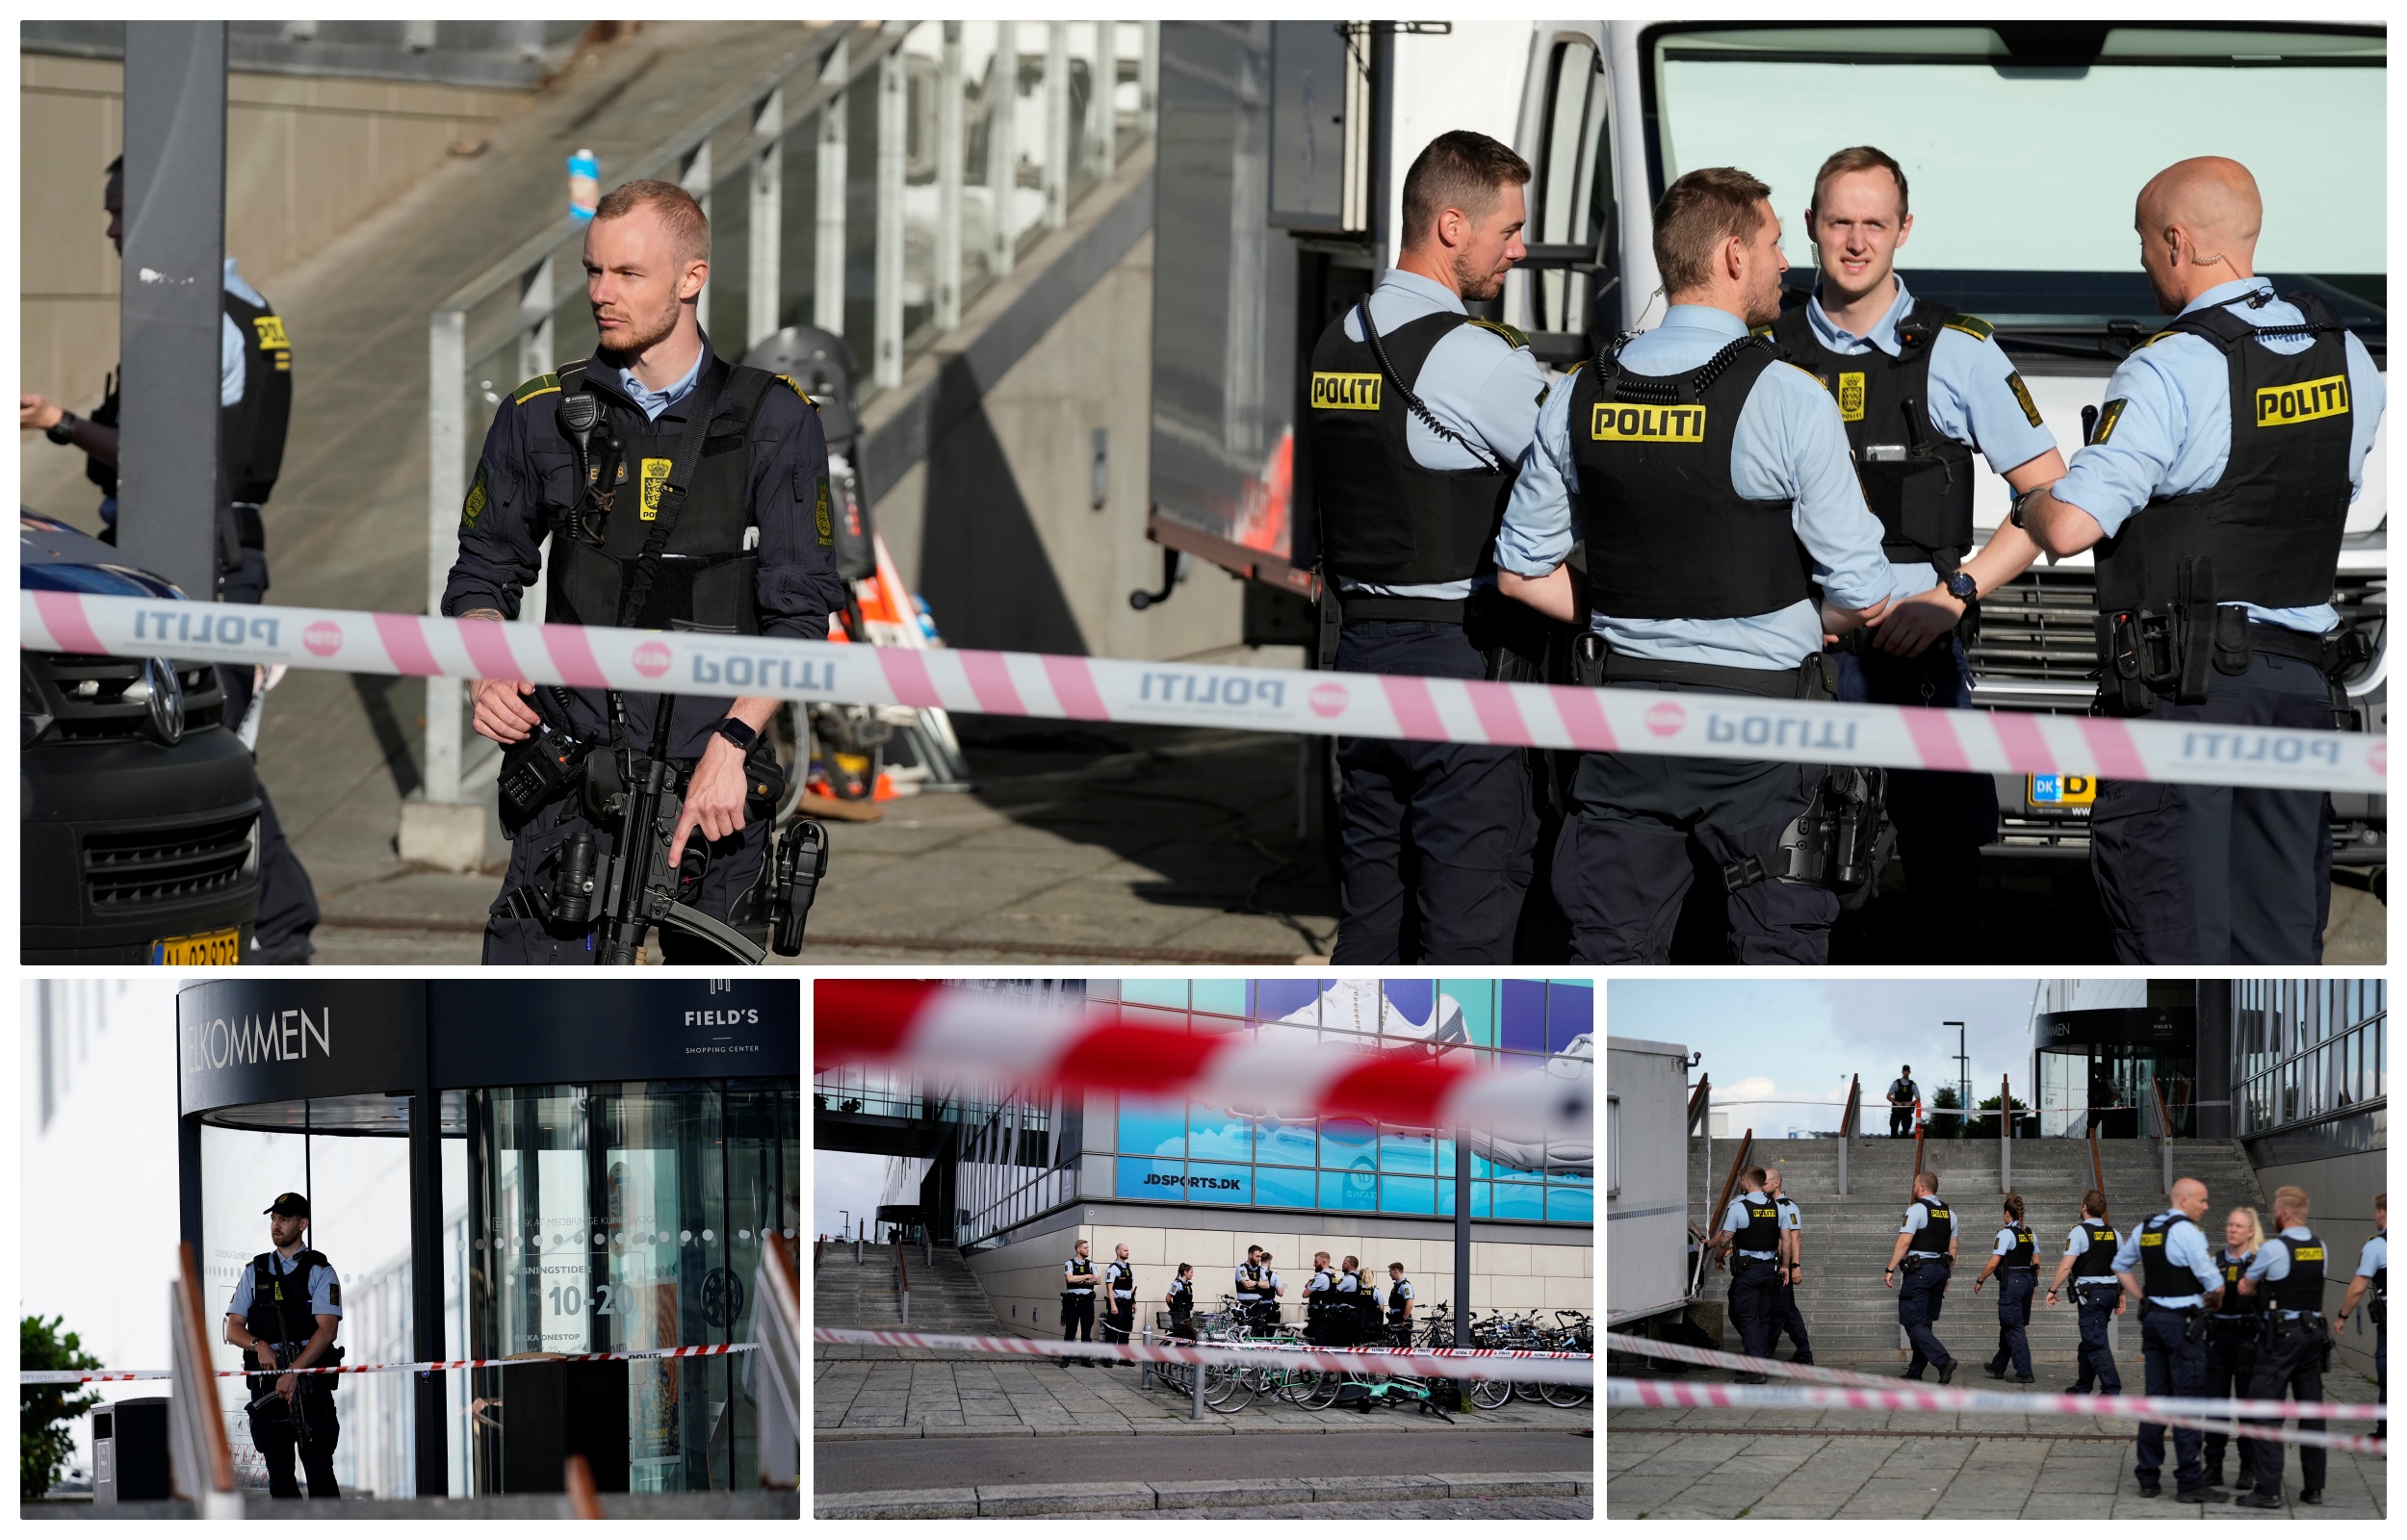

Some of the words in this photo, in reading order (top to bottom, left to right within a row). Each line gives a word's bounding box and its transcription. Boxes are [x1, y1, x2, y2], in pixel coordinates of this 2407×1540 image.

[1313, 377, 1380, 404] POLITI
[2259, 380, 2347, 421] POLITI
[1594, 408, 1702, 436] POLITI
[2036, 781, 2054, 793] DK
[685, 1009, 759, 1026] FIELD'S
[1143, 1173, 1241, 1191] JDSPORTS.DK
[549, 1284, 634, 1316] 10-20
